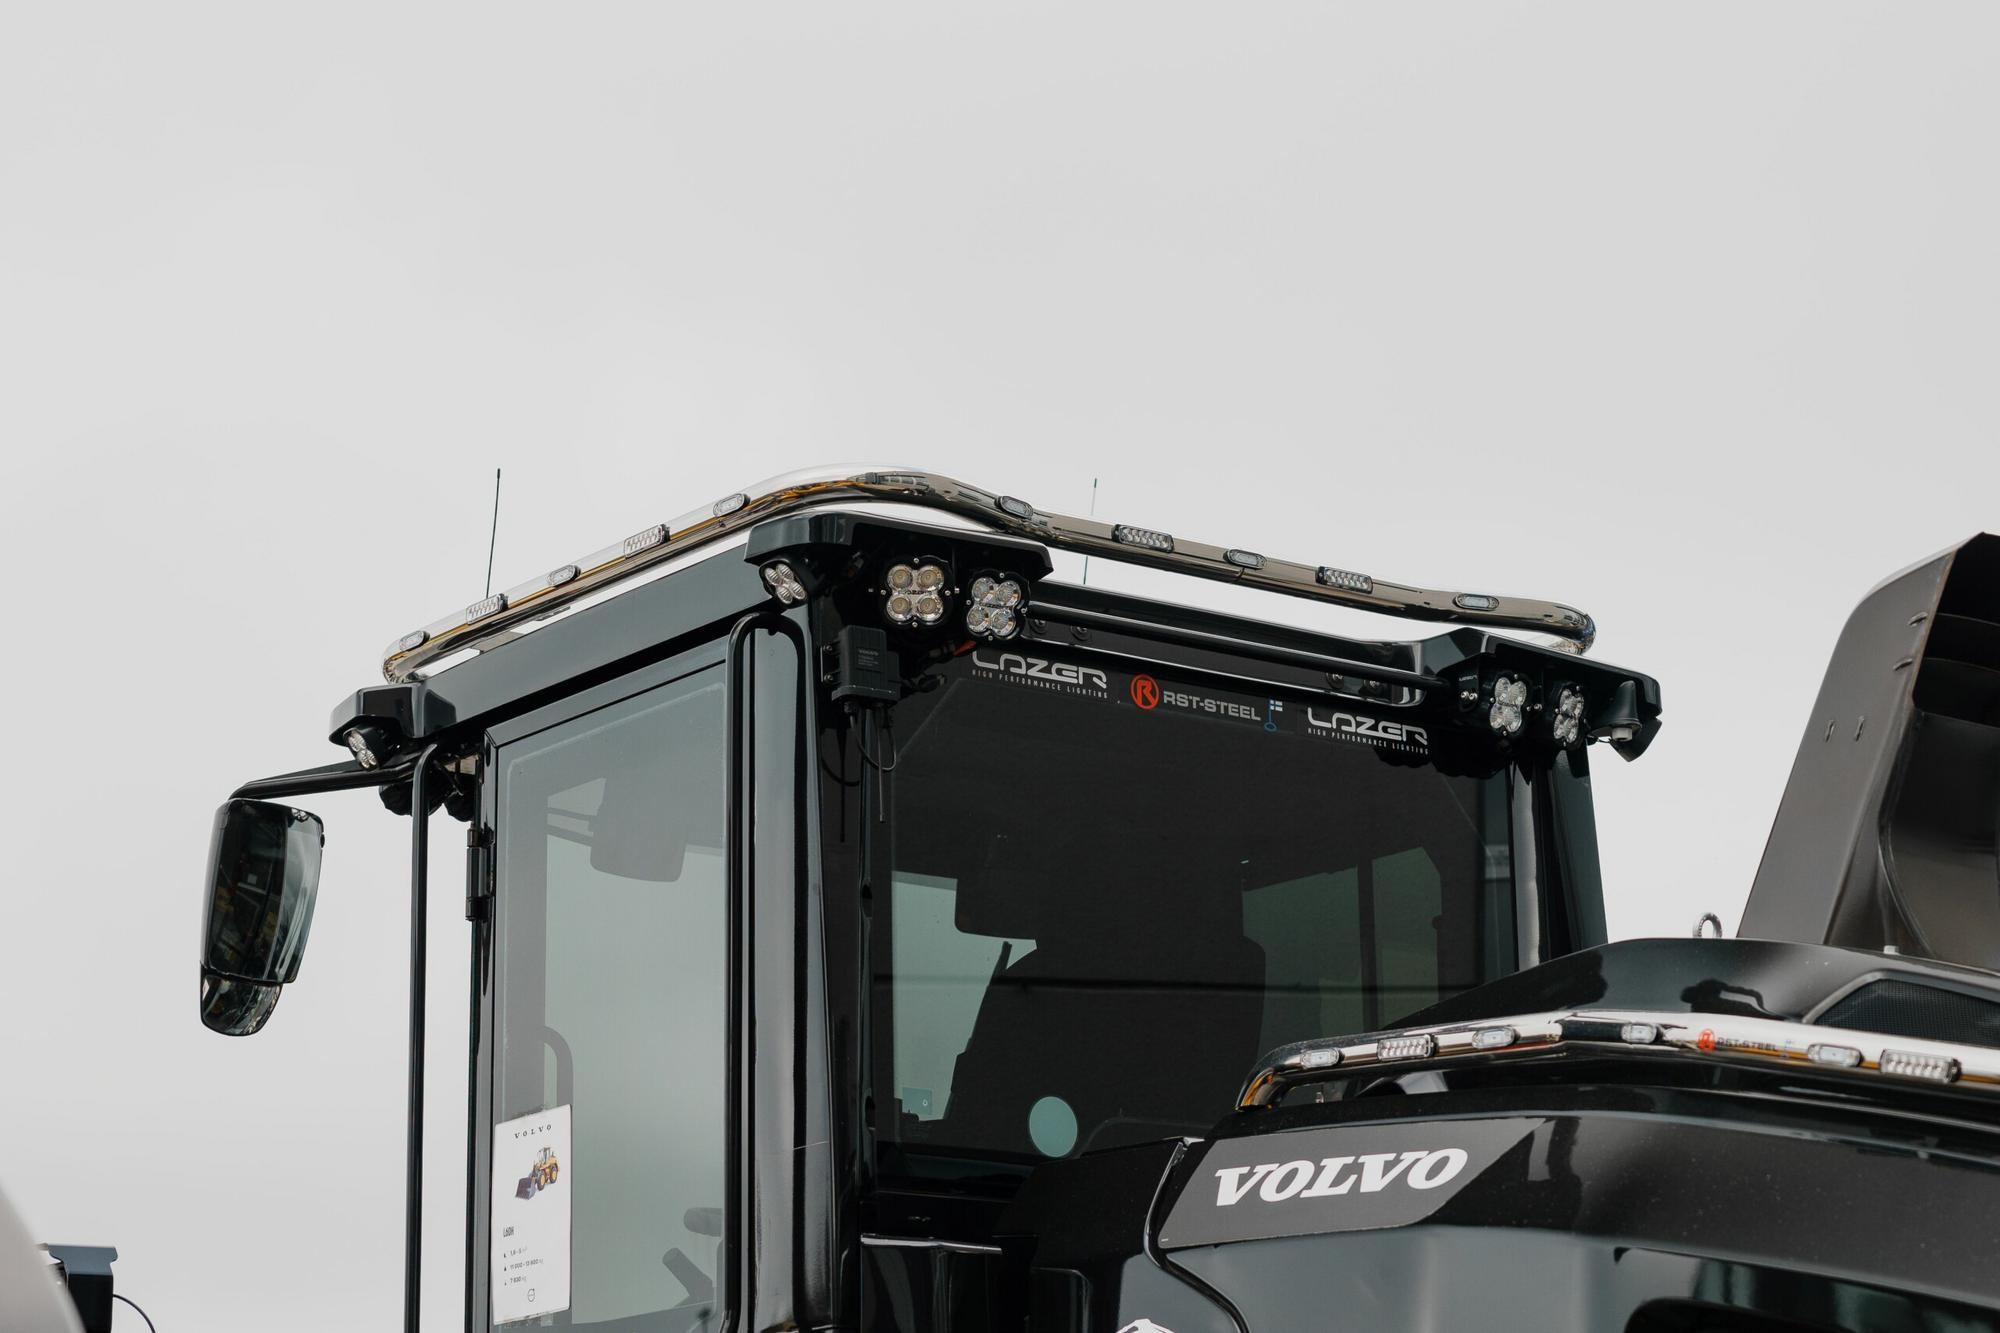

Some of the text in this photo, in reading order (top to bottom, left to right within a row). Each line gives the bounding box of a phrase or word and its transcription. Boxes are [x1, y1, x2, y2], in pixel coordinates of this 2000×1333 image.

[972, 650, 1107, 689] LAZER
[972, 669, 1108, 699] HIGH PERFORMANCE LIGHTING
[1163, 691, 1261, 721] RST-STEEL
[1307, 706, 1428, 746] LAZER
[1308, 727, 1429, 755] HIGH PERFORMANCE LIGHTING
[514, 1123, 552, 1139] VOLVO
[1214, 1147, 1469, 1207] VOLVO
